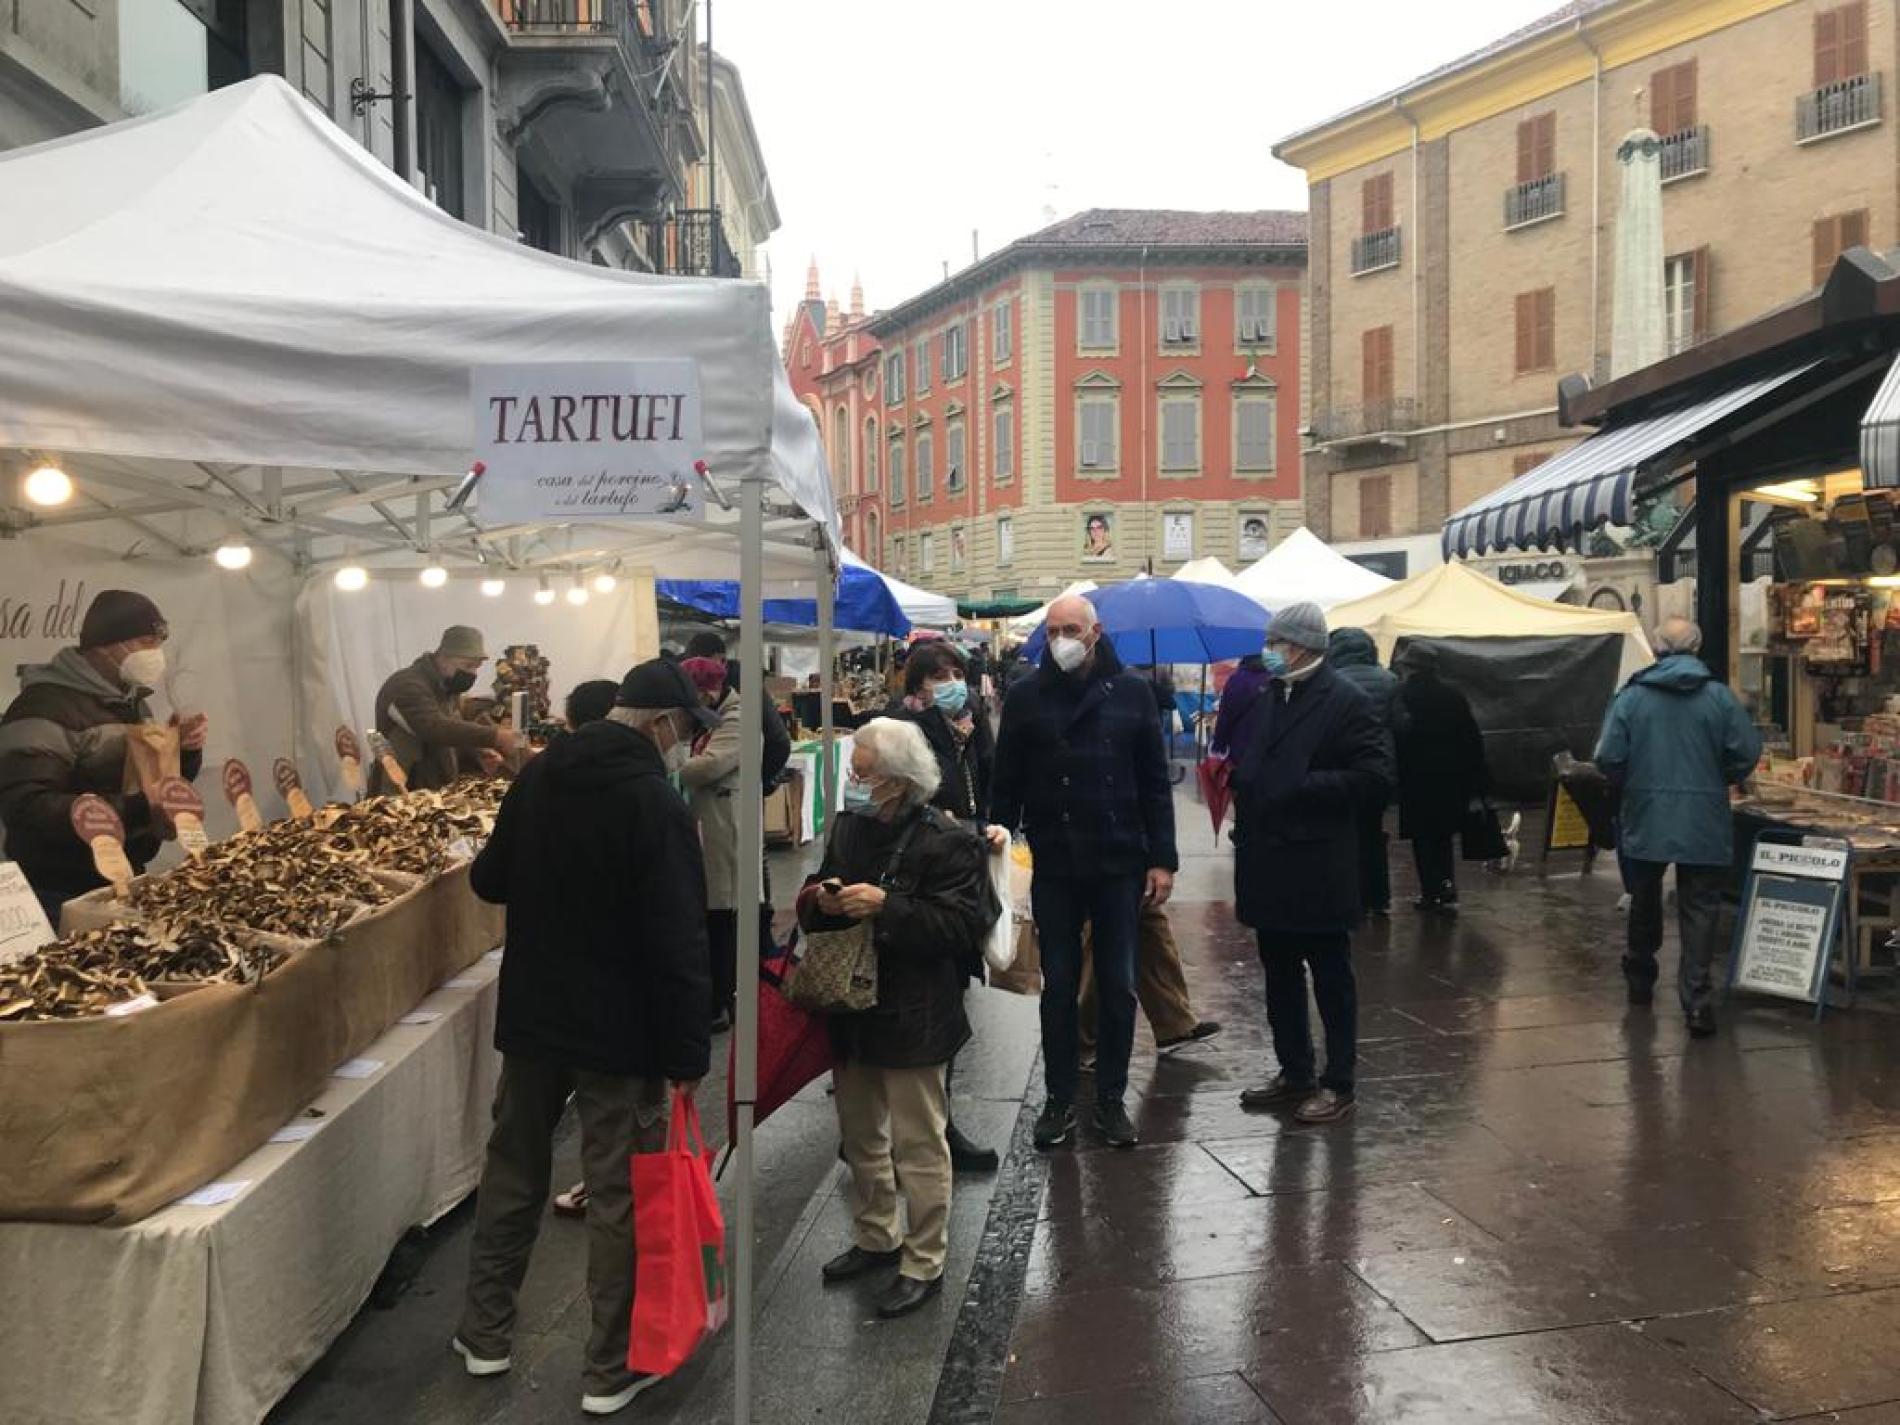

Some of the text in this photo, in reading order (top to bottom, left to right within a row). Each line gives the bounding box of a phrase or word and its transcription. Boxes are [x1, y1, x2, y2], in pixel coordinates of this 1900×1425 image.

[489, 394, 688, 443] TARTUFI
[536, 474, 572, 487] casa
[580, 489, 640, 513] tartufo
[42, 578, 86, 639] del
